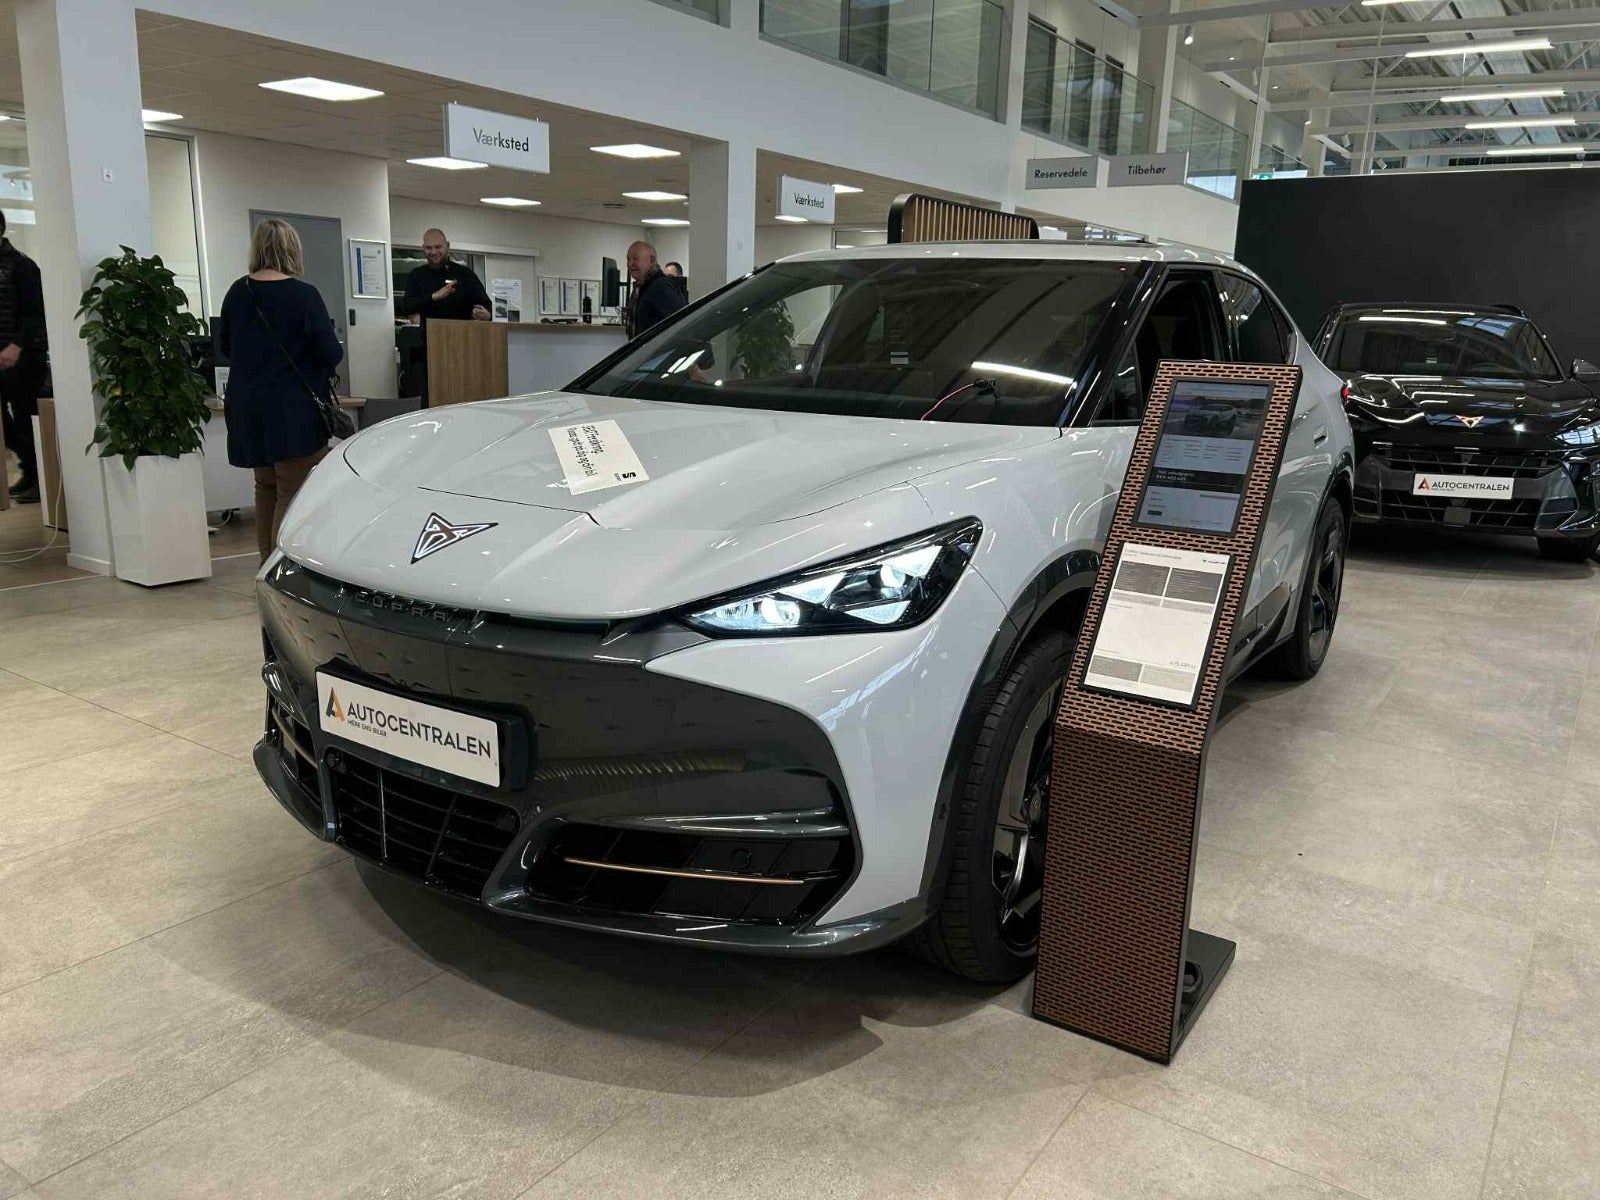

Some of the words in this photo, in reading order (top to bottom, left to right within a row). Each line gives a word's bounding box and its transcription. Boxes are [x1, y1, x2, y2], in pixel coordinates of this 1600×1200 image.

[473, 128, 529, 152] Værksted
[1034, 167, 1088, 178] Reservedele
[1127, 164, 1166, 175] Tilbehør
[794, 192, 825, 208] Værksted
[1431, 481, 1510, 491] AUTOCENTRALEN
[347, 719, 361, 729] MERE
[347, 701, 491, 759] AUTOCENTRALEN
